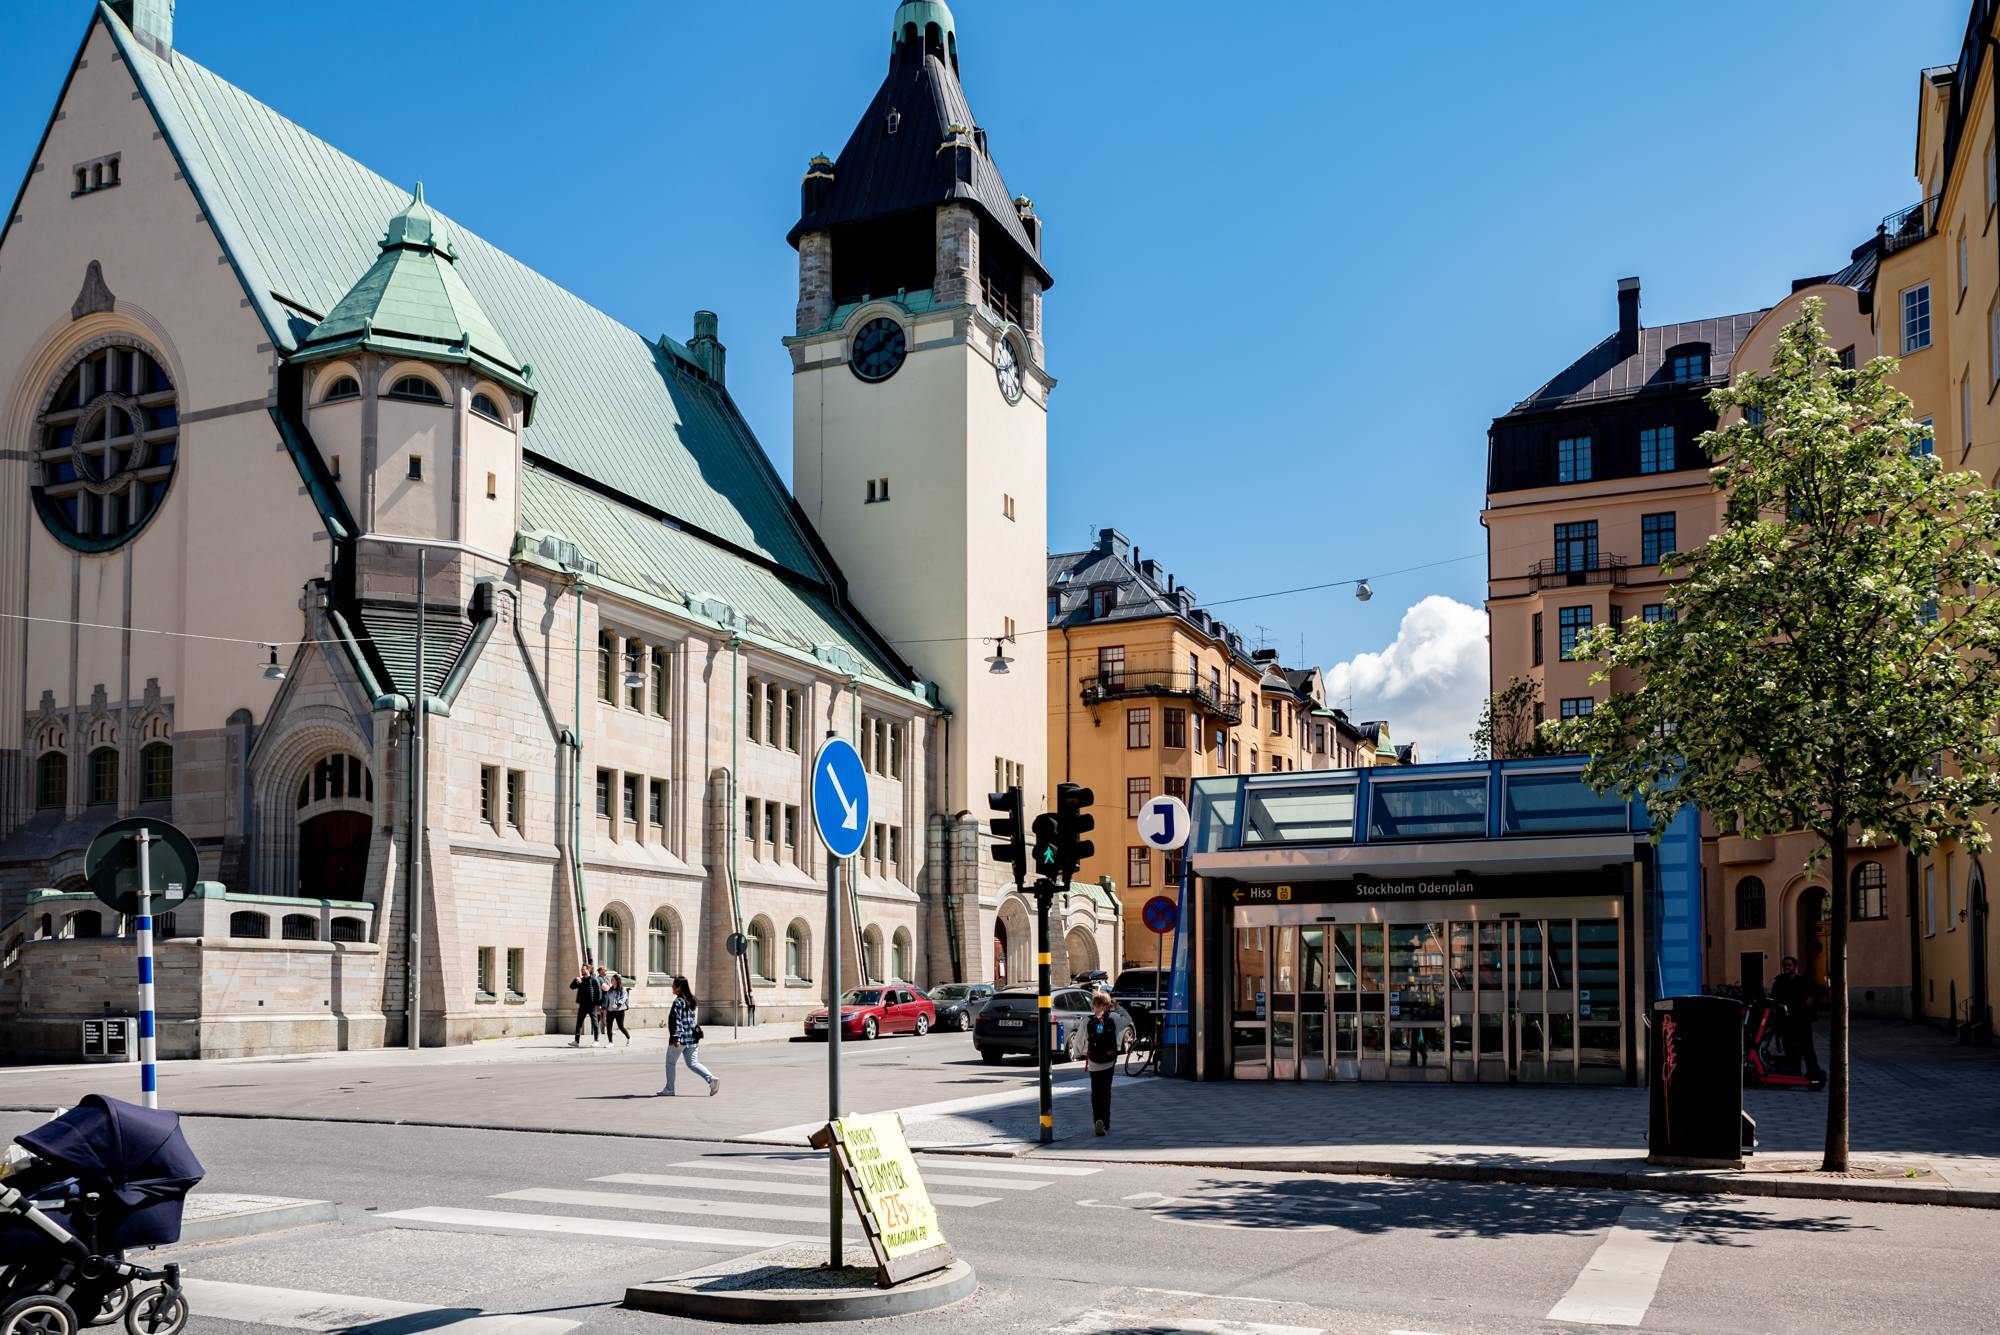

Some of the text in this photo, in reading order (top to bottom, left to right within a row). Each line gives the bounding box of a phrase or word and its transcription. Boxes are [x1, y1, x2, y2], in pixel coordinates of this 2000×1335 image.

[1150, 804, 1175, 845] J
[1250, 887, 1272, 899] Hiss
[1356, 880, 1474, 896] Stockholm Odenplan
[862, 1160, 909, 1195] HUMMER
